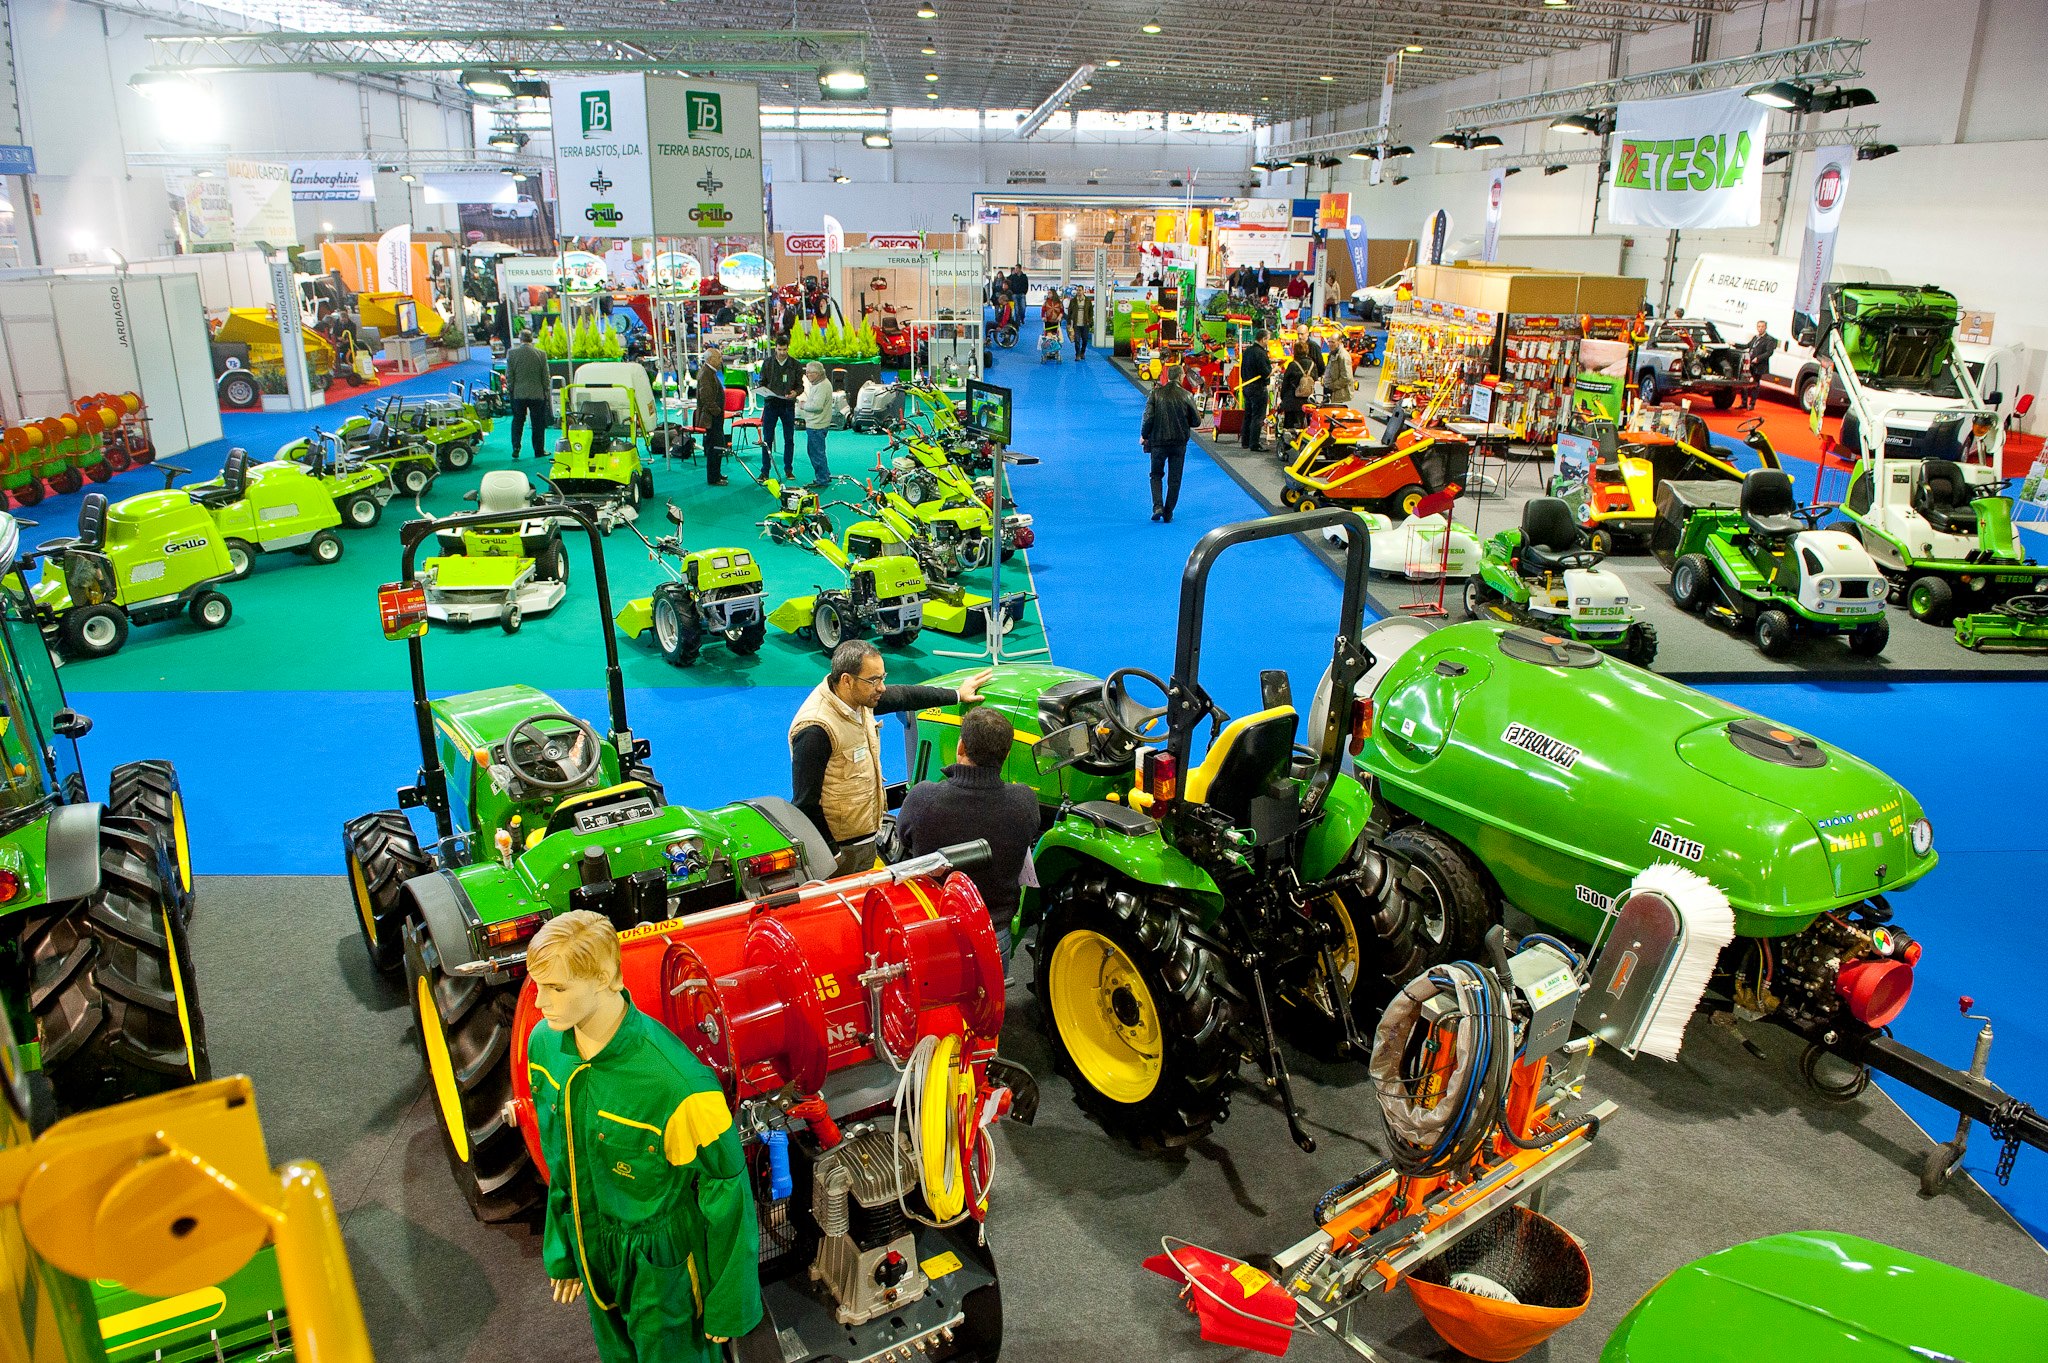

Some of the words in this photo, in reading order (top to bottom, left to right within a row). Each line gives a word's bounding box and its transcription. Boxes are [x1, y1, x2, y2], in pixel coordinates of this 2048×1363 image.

[559, 146, 583, 158] TERRA
[585, 144, 620, 159] BASTOS,
[622, 144, 643, 156] LDA.
[657, 144, 690, 156] TERRA
[692, 145, 733, 161] BASTOS,
[734, 147, 755, 160] LDA.
[1614, 130, 1752, 192] ETESIA
[291, 168, 359, 189] Lamborghini
[1820, 178, 1838, 201] FIAT
[585, 208, 623, 222] Grillo
[688, 208, 733, 222] Grillo
[874, 240, 918, 249] OREGON
[508, 269, 530, 277] TERRA
[932, 269, 953, 277] TERRA
[955, 269, 979, 277] BASTOS
[1805, 240, 1823, 311] PROFESSIONAL
[1708, 273, 1716, 284] A.
[1718, 274, 1741, 288] BRAZ
[1742, 278, 1779, 294] HELENO
[275, 270, 291, 334] MAQUIGARDEN
[111, 286, 129, 348] JARDIAGRO
[1885, 437, 1903, 445] orino
[352, 474, 373, 485] Grillo
[164, 538, 208, 554] Grillo
[721, 570, 751, 579] Grillo
[1995, 575, 2033, 584] ETESIA
[895, 579, 921, 588] Grillo
[1579, 607, 1625, 616] ETESIA
[1835, 606, 1867, 614] ETESIA
[1651, 829, 1703, 861] AB1115
[1576, 885, 1608, 909] 1500
[617, 920, 679, 939] ORBINS
